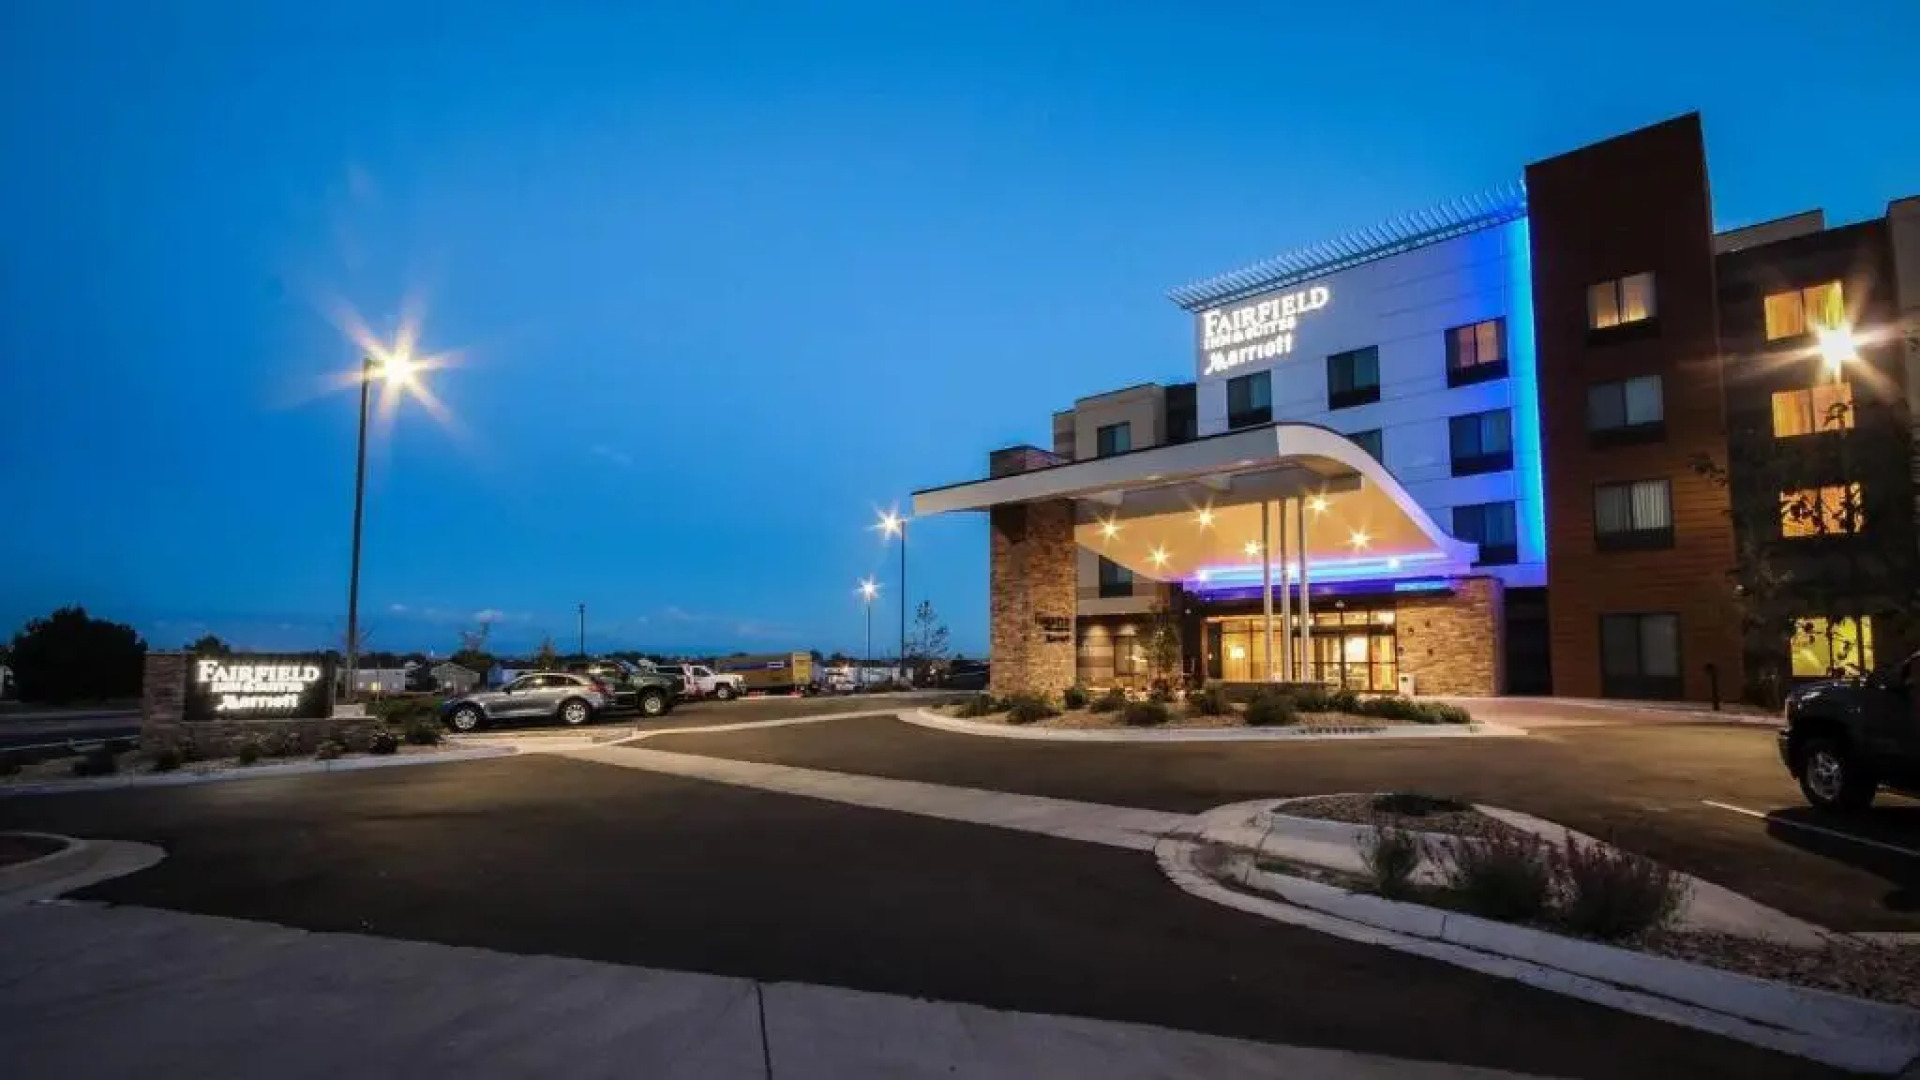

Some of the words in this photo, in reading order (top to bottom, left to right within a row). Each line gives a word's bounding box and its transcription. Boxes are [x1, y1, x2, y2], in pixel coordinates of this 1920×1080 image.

[1203, 286, 1329, 337] FAIRFIELD
[1203, 332, 1293, 375] Marriott
[198, 659, 320, 682] FAIRFIELD
